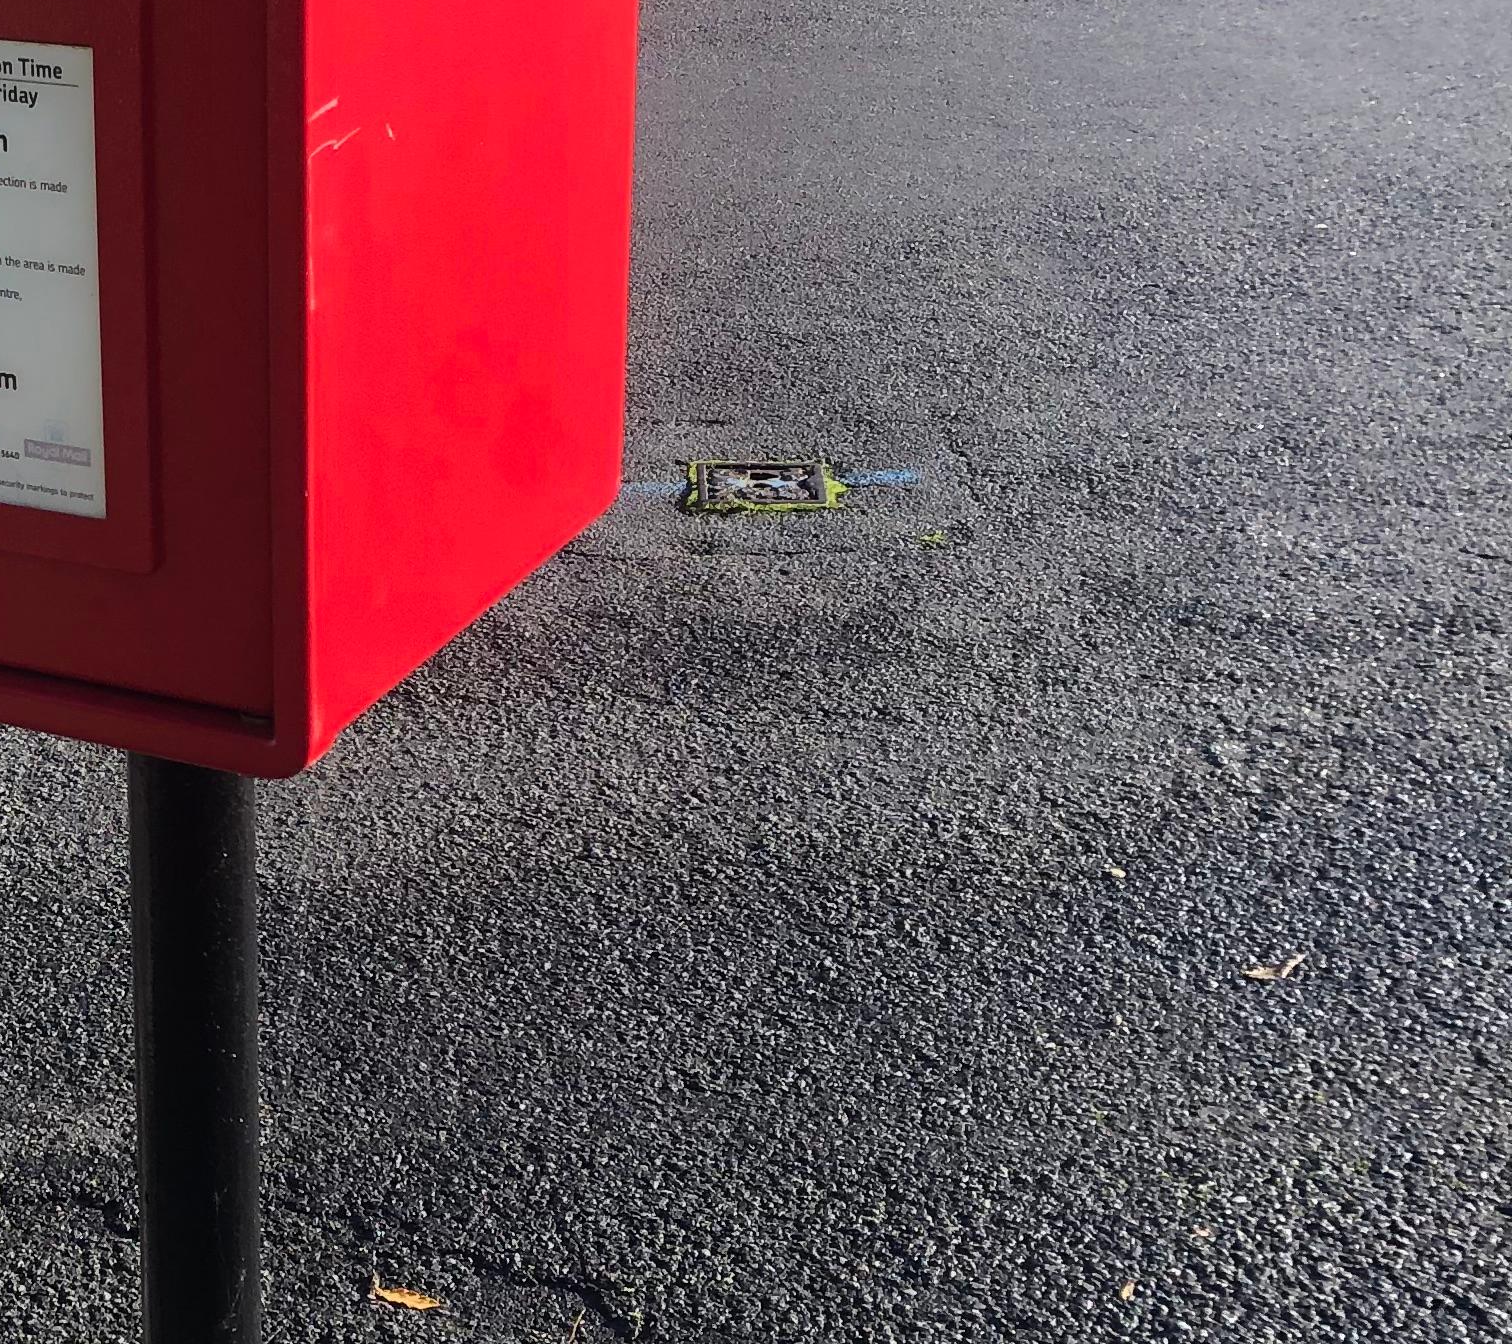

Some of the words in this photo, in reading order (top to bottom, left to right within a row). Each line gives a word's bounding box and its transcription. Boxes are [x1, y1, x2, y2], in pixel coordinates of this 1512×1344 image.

[18, 57, 63, 80] Time
[29, 181, 37, 190] is
[40, 181, 68, 194] made
[4, 255, 21, 269] the
[23, 259, 44, 272] area
[47, 261, 56, 273] is
[58, 264, 86, 277] made
